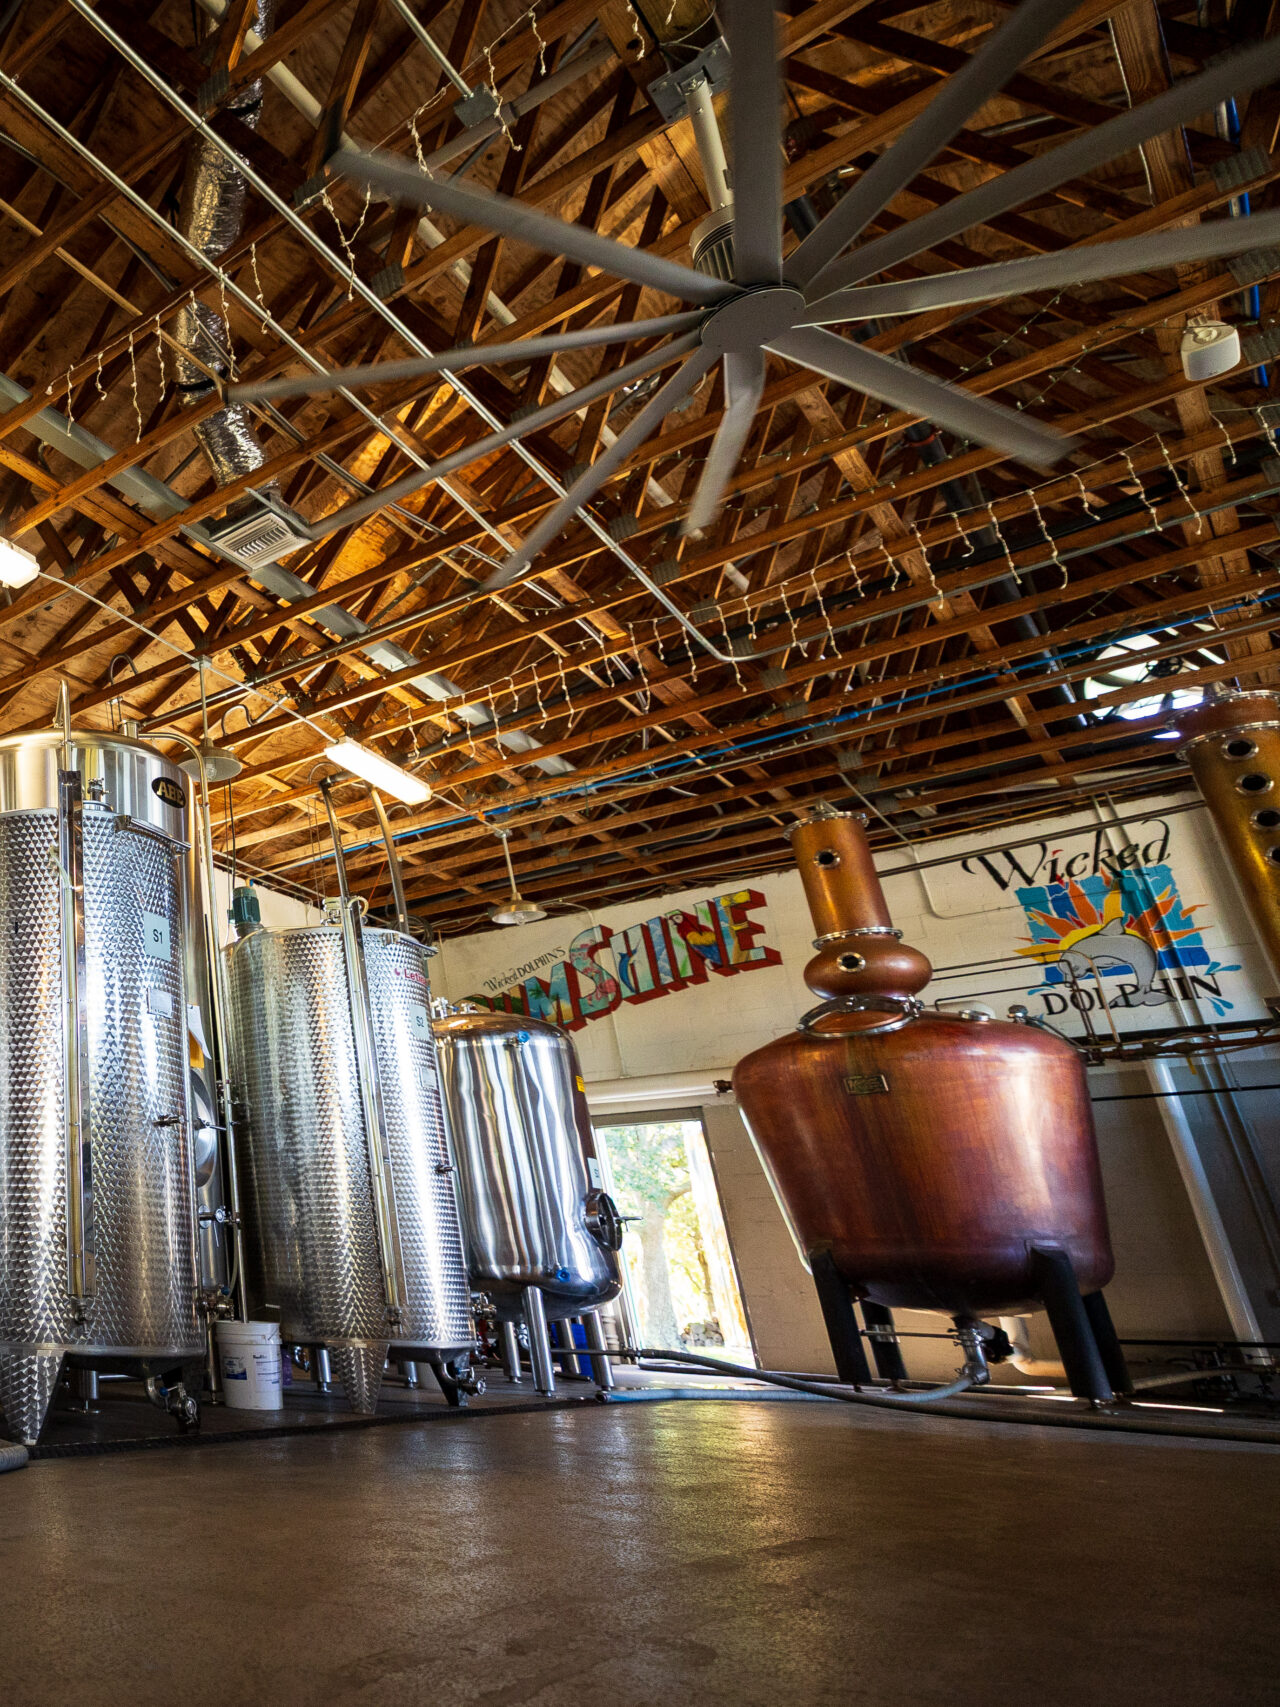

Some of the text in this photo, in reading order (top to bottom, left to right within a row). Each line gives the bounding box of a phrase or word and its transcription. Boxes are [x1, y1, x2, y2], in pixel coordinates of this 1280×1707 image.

[156, 780, 184, 806] ABE
[961, 819, 1171, 891] Wicked
[152, 928, 163, 944] S1
[483, 967, 519, 992] Wicked
[416, 1015, 424, 1028] S2
